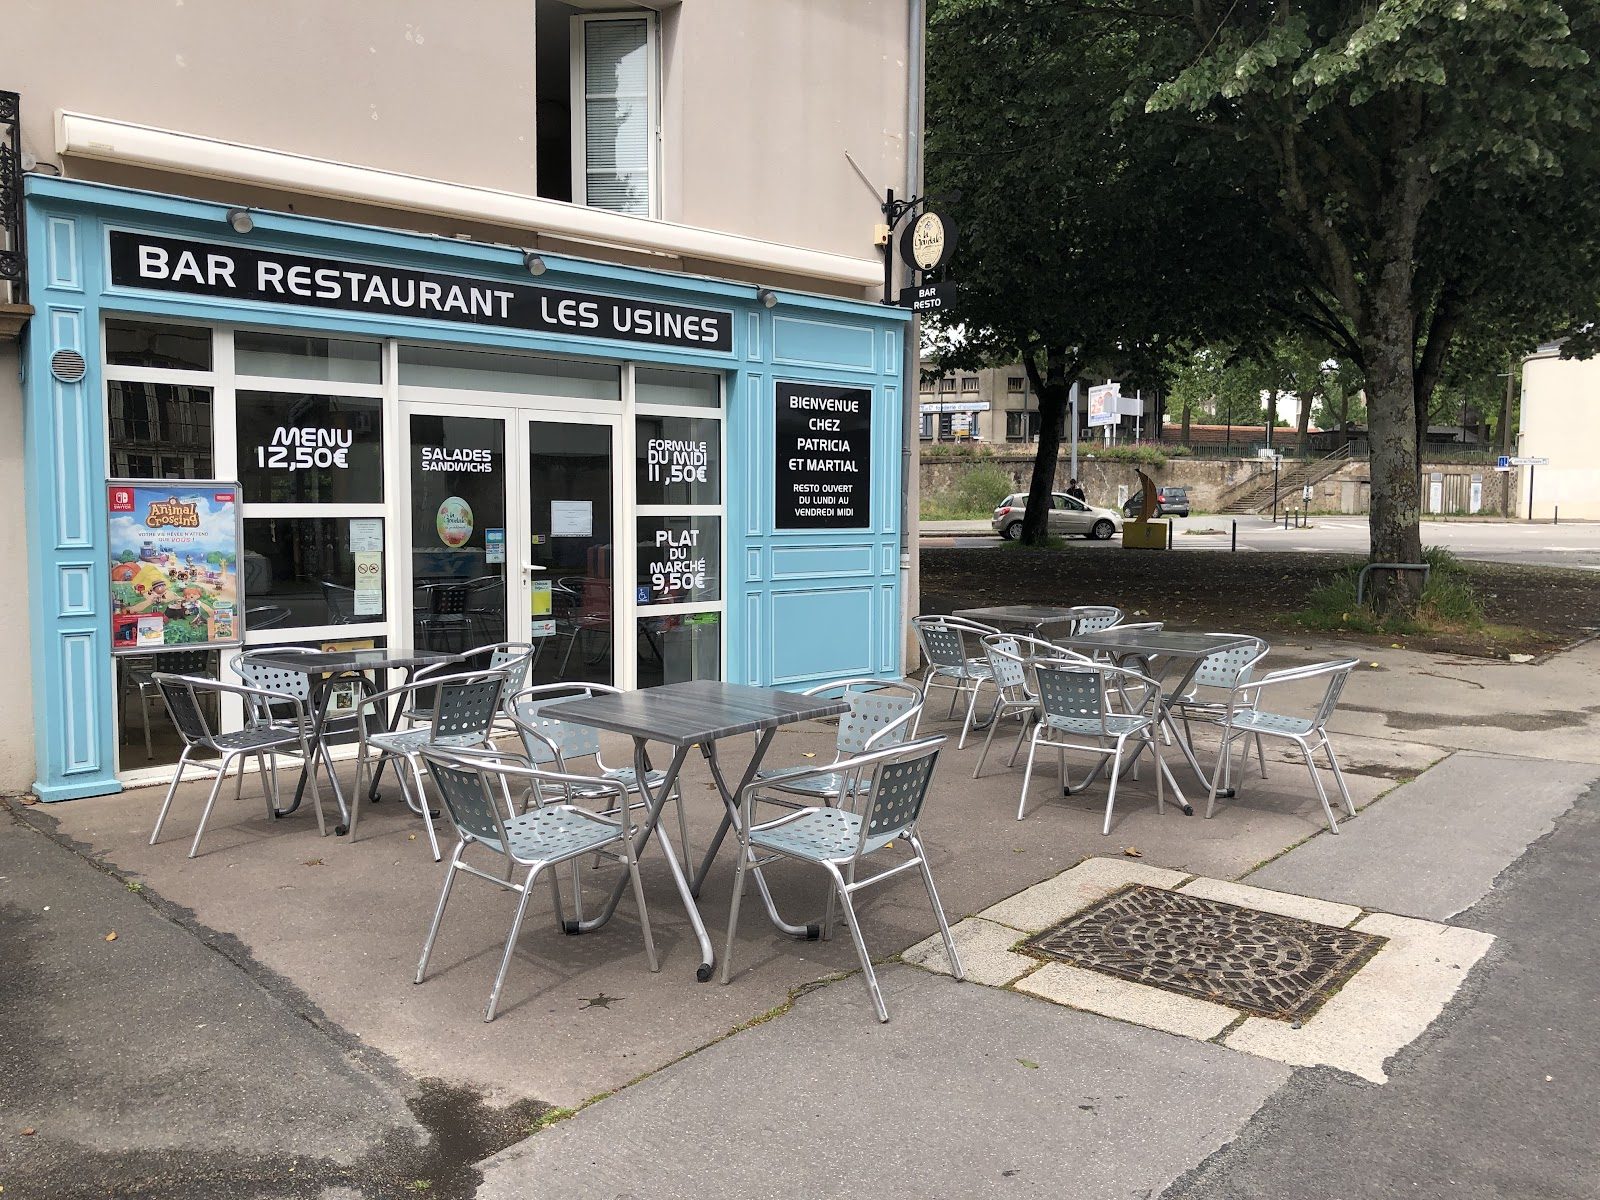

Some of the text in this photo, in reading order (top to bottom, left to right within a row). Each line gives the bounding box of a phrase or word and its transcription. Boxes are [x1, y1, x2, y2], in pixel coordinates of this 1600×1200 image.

[138, 244, 719, 343] BAR RESTAURANT LES USINES
[919, 287, 936, 298] BAR
[913, 298, 941, 310] RESTO
[789, 395, 859, 413] BIENVENUE
[808, 418, 841, 432] CHEZ
[271, 426, 353, 448] MENU
[648, 439, 707, 452] FORMULE
[797, 438, 851, 452] PATRICIA
[257, 446, 349, 472] 12,50€
[421, 447, 492, 462] SALADES
[648, 449, 707, 466] DU MIDI
[421, 461, 493, 473] SANDWICHS
[788, 458, 859, 473] ET MARTIAL
[793, 483, 853, 493] RESTO OUVERT
[798, 496, 849, 505] DU LUNDI AU
[151, 503, 194, 516] Animal
[794, 508, 854, 517] VENDREDI MIDI
[147, 514, 198, 526] Crossing
[655, 529, 700, 548] PLAT
[669, 548, 687, 560] DU
[649, 556, 706, 575] MARCHÉ
[652, 573, 706, 595] 9,50€
